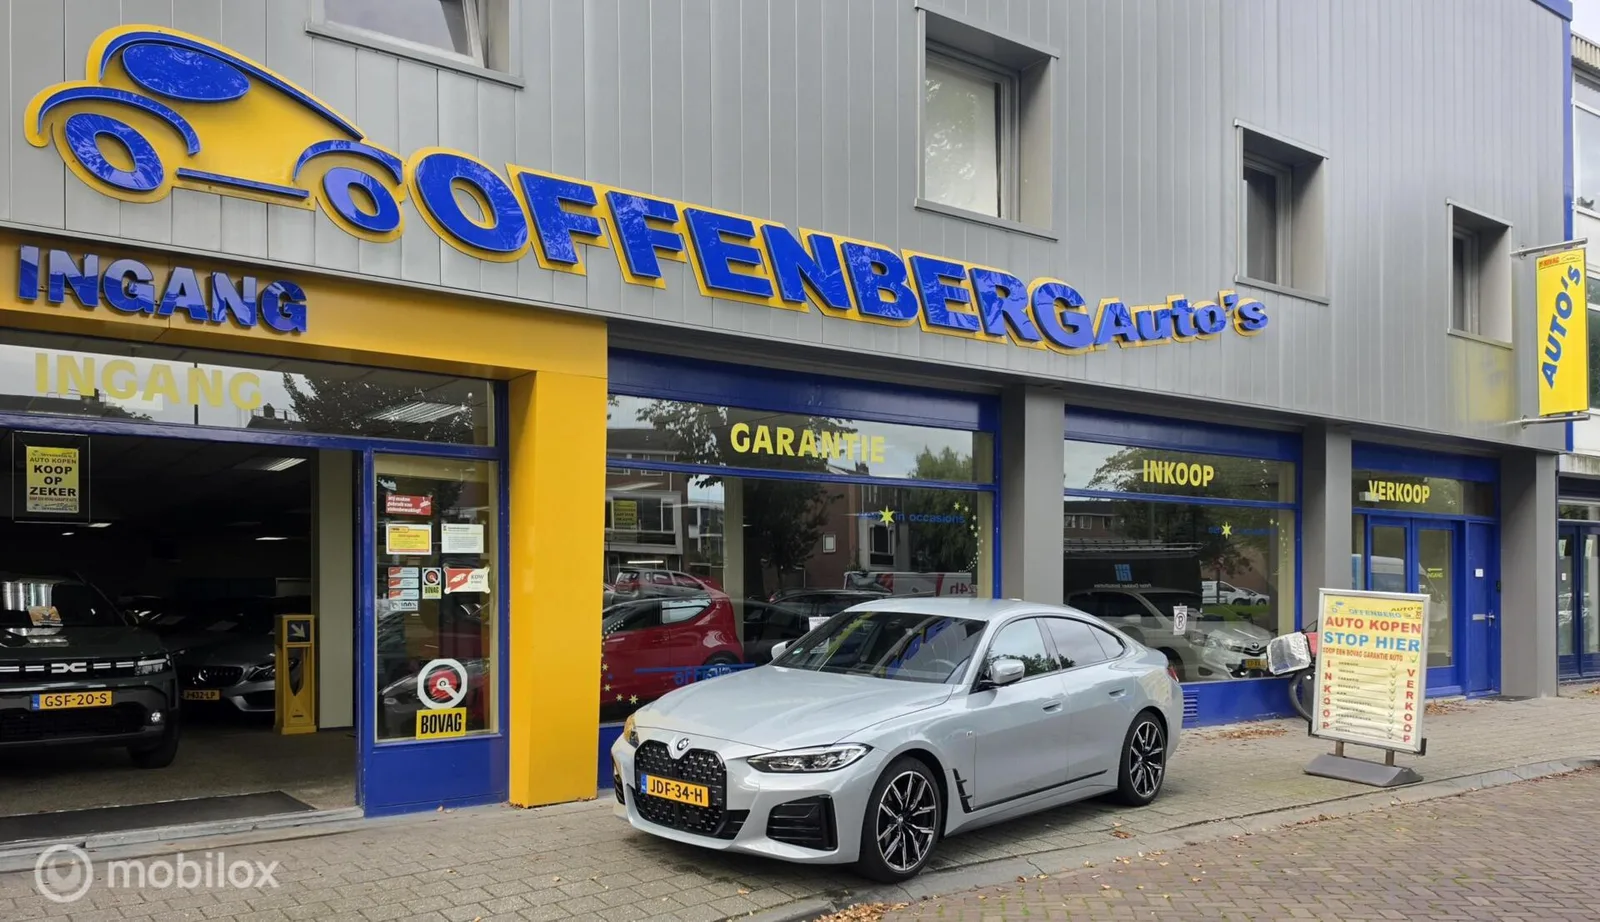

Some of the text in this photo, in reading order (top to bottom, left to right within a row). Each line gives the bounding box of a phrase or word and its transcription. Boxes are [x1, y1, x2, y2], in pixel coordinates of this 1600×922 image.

[412, 150, 1269, 351] OFFENBERG Auto's
[18, 244, 307, 333] INGANG
[1541, 264, 1582, 390] AUTO'S
[35, 352, 263, 411] INGANG
[730, 422, 886, 464] GARANTIE
[33, 464, 73, 475] KOOP
[1143, 459, 1215, 488] INKOOP
[29, 486, 77, 497] ZEKER
[43, 476, 63, 486] OP
[1368, 479, 1431, 504] VERKOOP
[909, 513, 966, 524] occasions
[1325, 616, 1422, 634] AUTO KOPEN
[1323, 631, 1421, 653] STOP HIER
[44, 692, 107, 707] GSF-20-S
[421, 712, 462, 734] BOVAG
[649, 781, 703, 803] JDF-34-H
